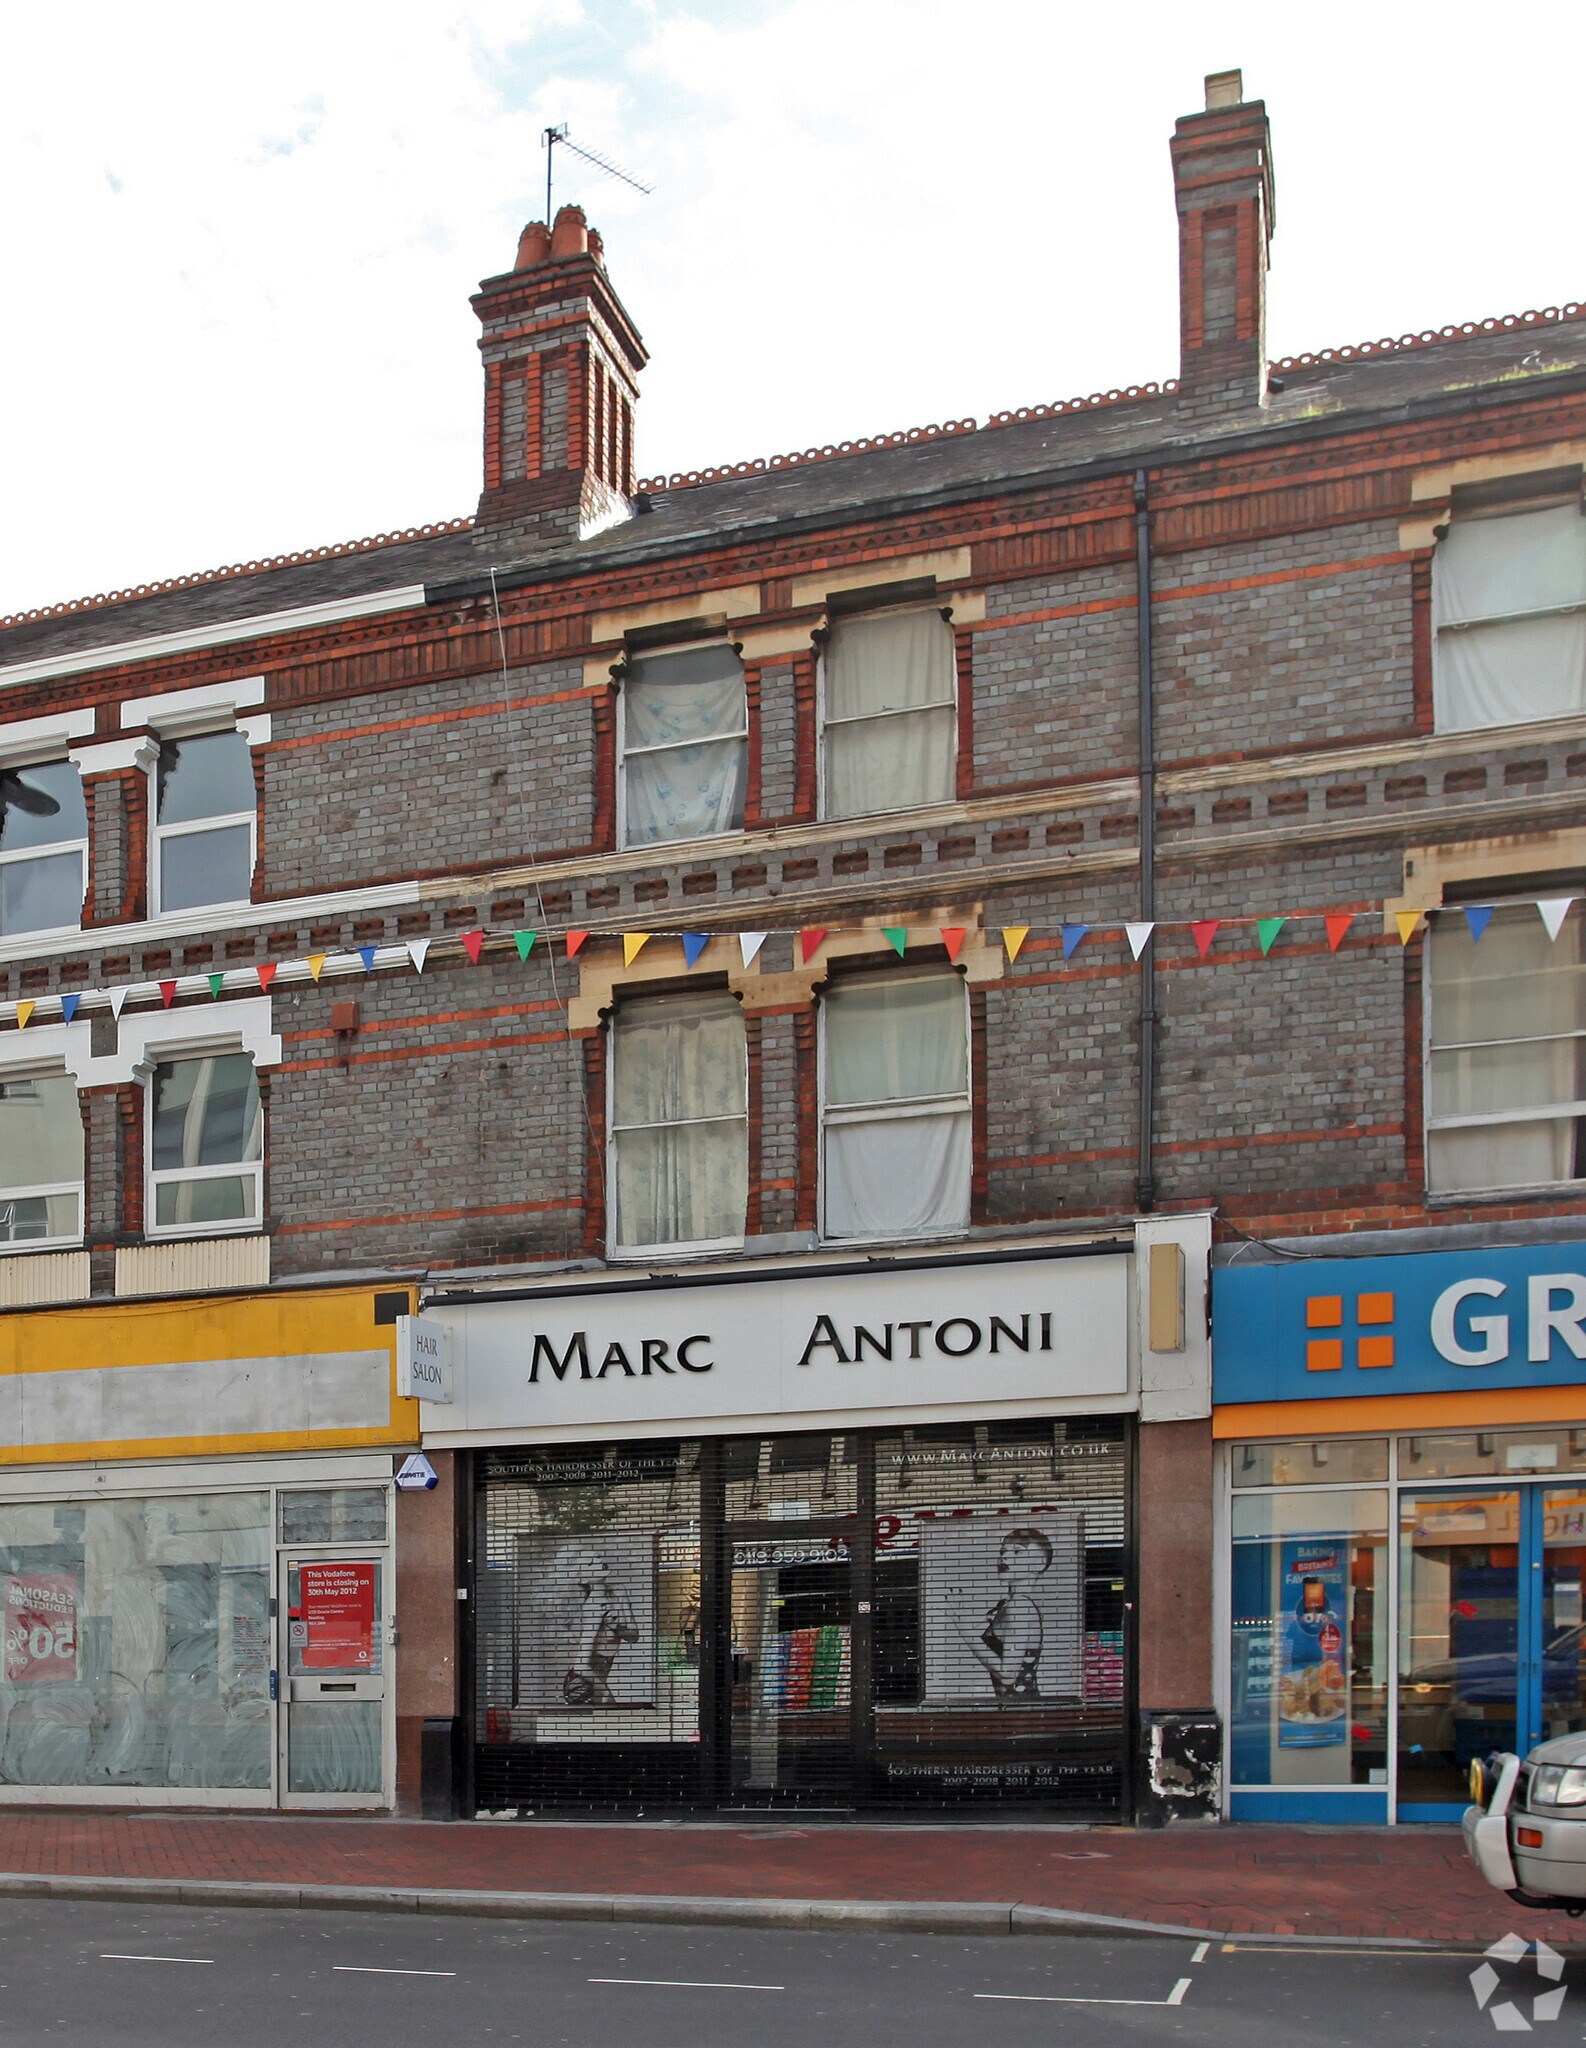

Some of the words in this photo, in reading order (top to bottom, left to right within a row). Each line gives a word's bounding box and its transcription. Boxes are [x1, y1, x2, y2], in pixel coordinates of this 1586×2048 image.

[1431, 1273, 1586, 1366] GR
[416, 1334, 438, 1356] HAIR
[413, 1361, 442, 1385] SALON
[488, 1464, 543, 1475] SOUTHERN
[547, 1460, 615, 1471] HAIRDRESSER
[1297, 1547, 1335, 1558] BAKING
[323, 1570, 356, 1578] Vodafone
[1286, 1574, 1342, 1585] FAVRITES
[308, 1579, 325, 1588] store
[333, 1578, 359, 1589] closing
[307, 1588, 324, 1596] 30th
[324, 1588, 339, 1597] May
[340, 1587, 357, 1596] 2012
[887, 1765, 950, 1776] SOUTHERN
[953, 1765, 1031, 1775] HAIRDRESSER
[1036, 1765, 1053, 1775] OF
[1058, 1766, 1079, 1775] THE
[1083, 1765, 1114, 1775] YEAR
